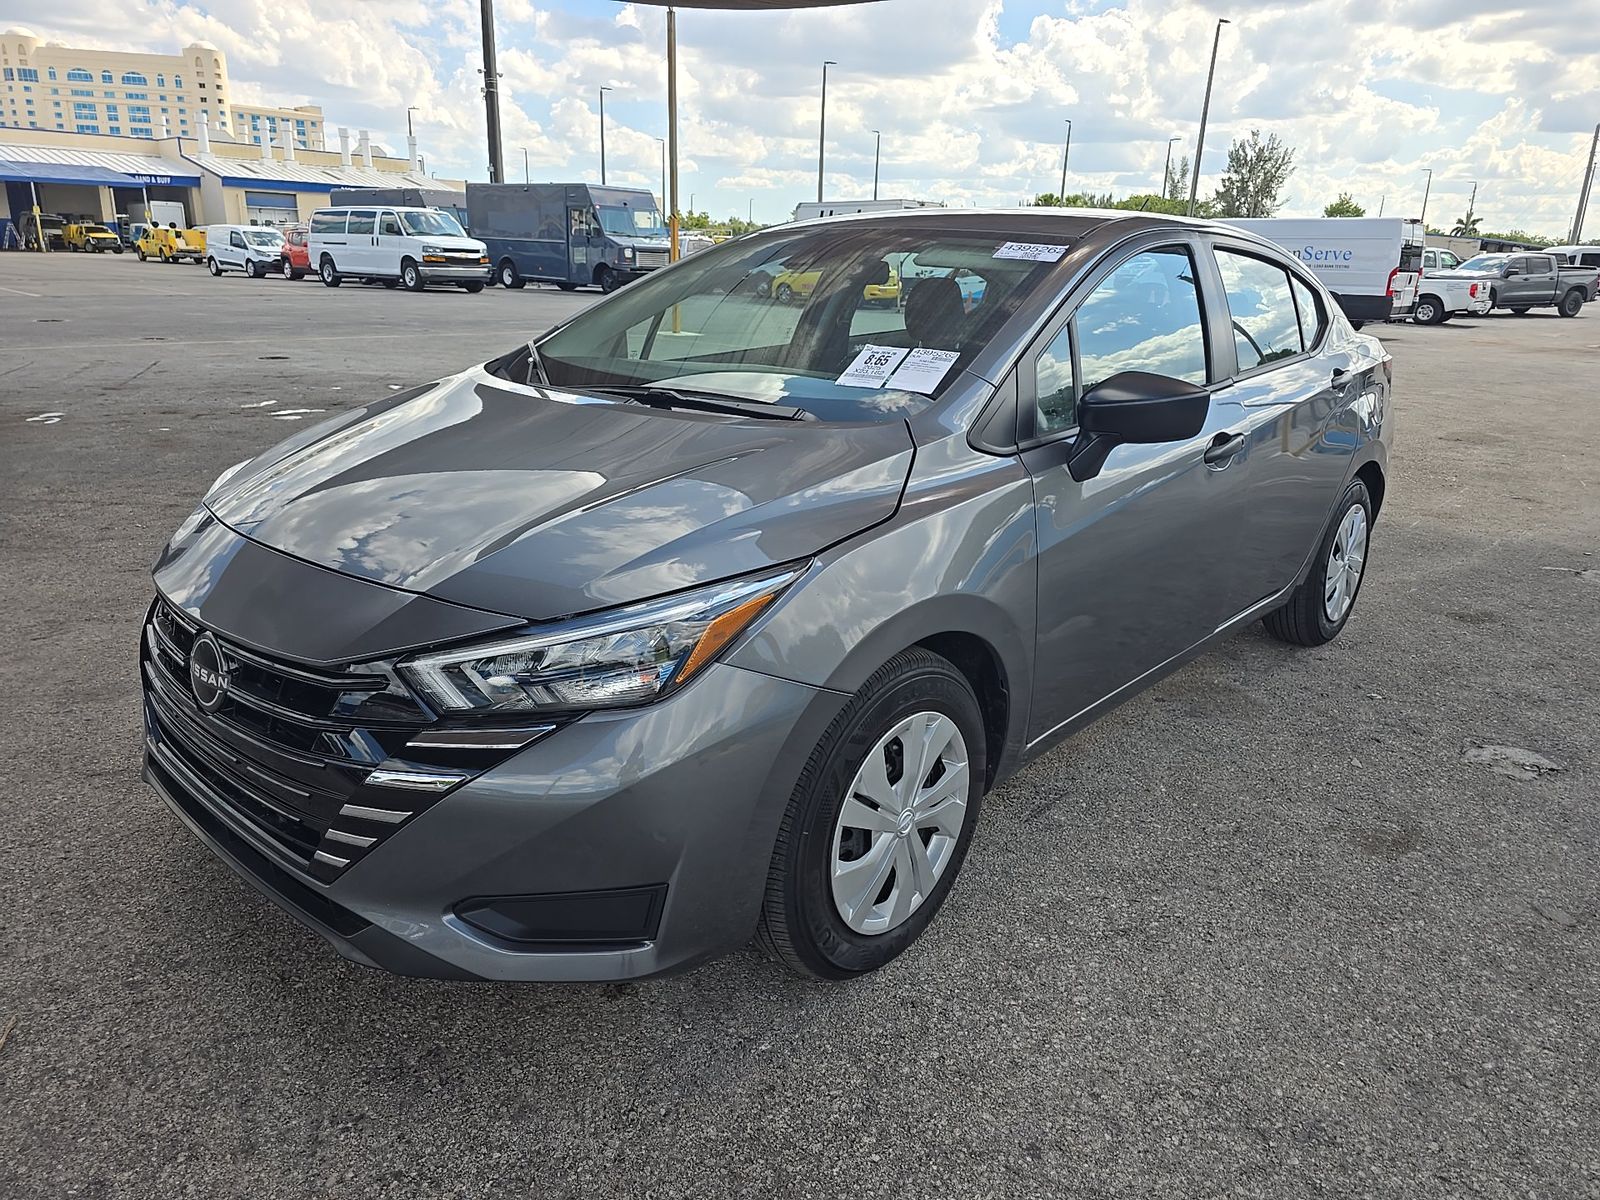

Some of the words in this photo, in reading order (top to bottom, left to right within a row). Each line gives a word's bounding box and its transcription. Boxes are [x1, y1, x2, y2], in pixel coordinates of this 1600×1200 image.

[157, 176, 171, 184] BUFF
[1292, 245, 1353, 261] nServe
[864, 353, 892, 366] 8:65
